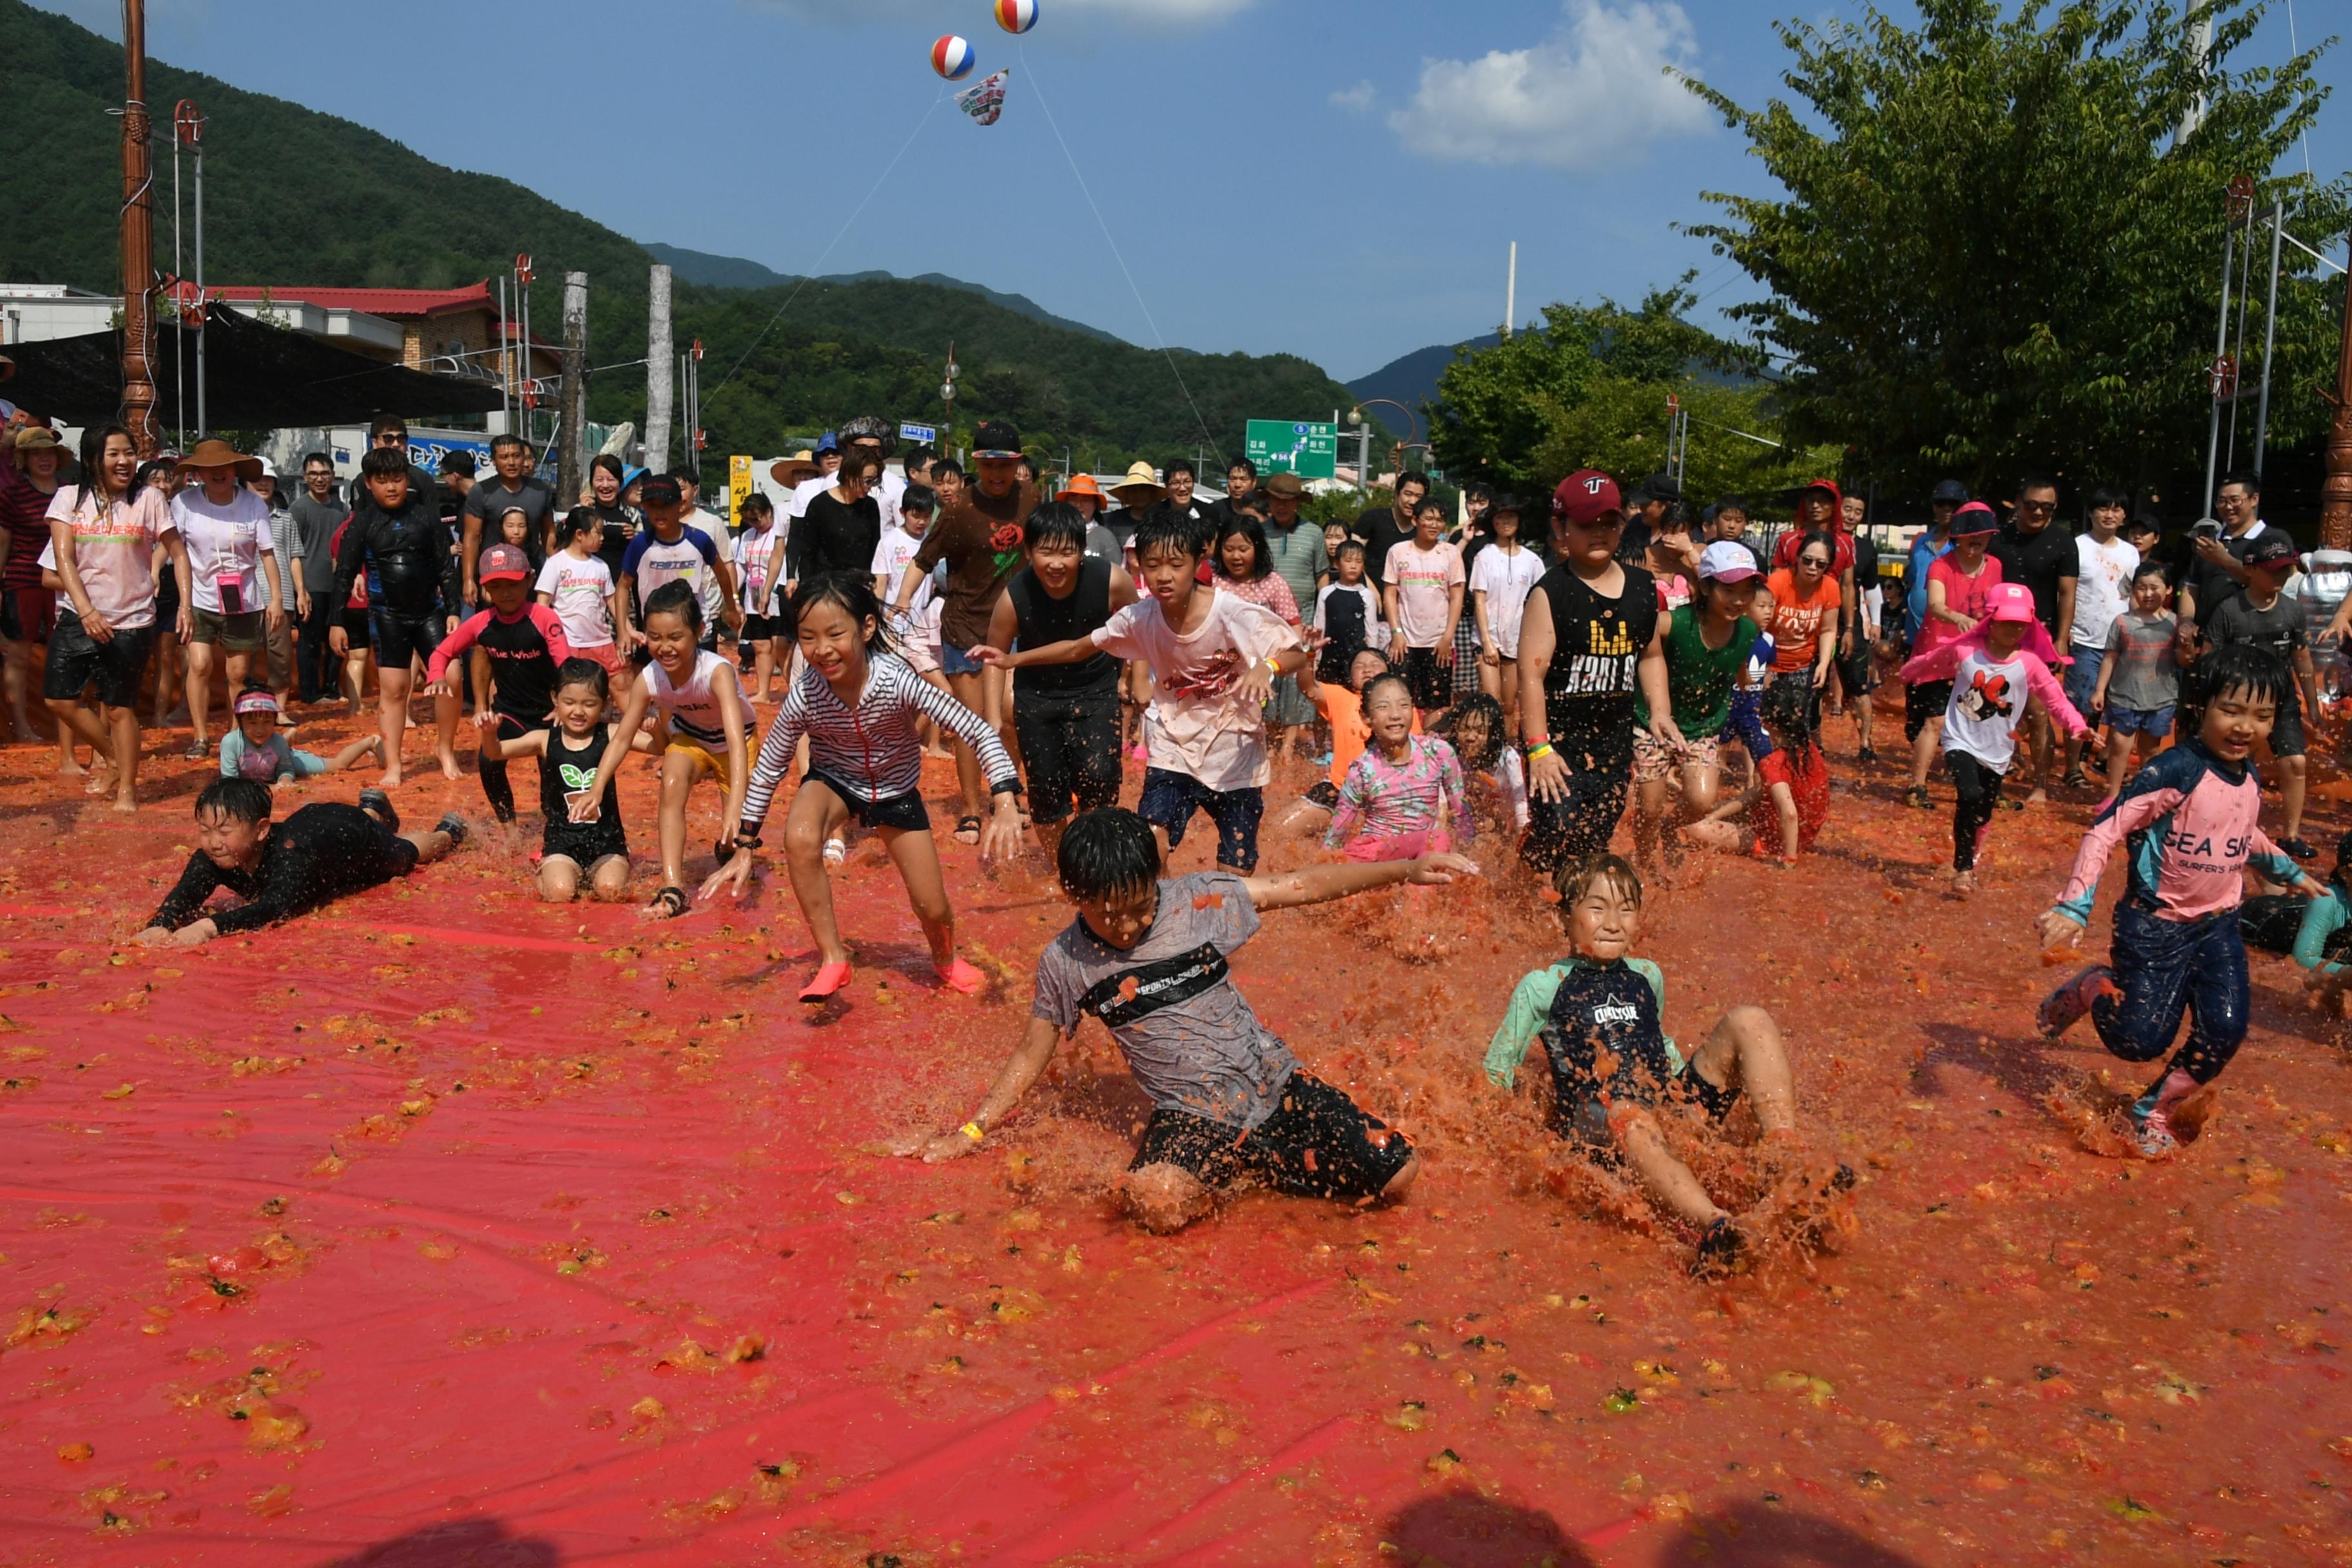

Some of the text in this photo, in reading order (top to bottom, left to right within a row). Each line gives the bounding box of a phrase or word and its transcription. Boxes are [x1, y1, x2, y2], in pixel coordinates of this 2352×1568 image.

[1583, 476, 1605, 495] T
[649, 560, 696, 570] FASTER
[510, 649, 540, 660] Whale
[2163, 830, 2212, 857] SEA
